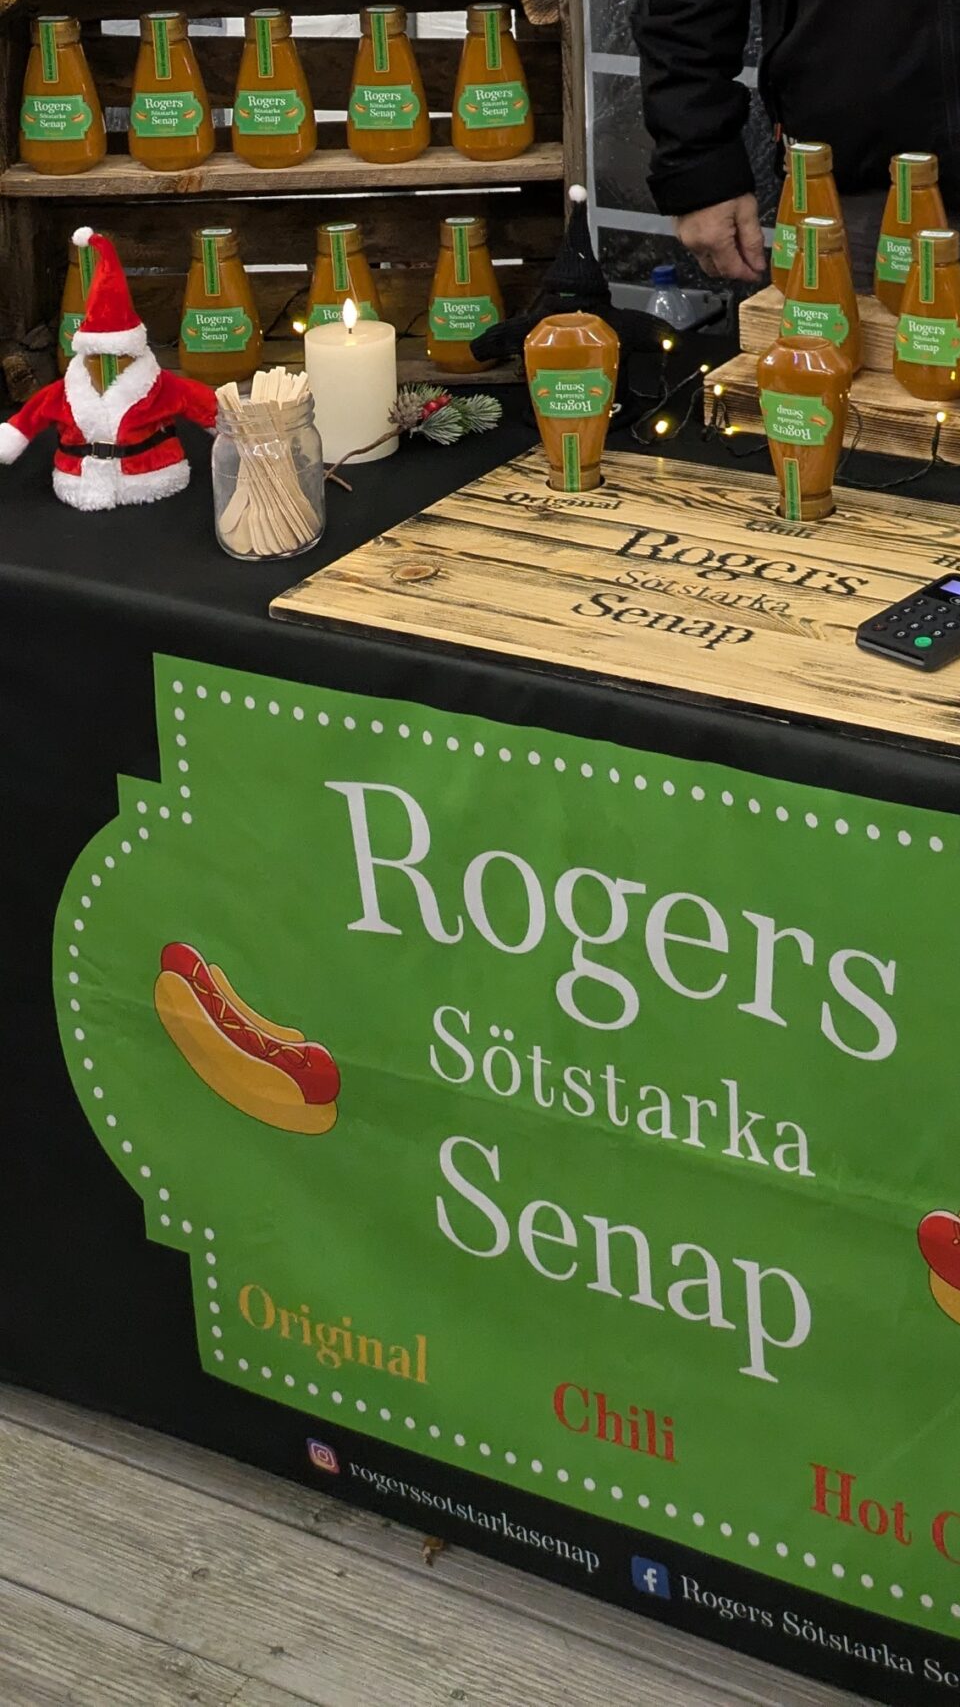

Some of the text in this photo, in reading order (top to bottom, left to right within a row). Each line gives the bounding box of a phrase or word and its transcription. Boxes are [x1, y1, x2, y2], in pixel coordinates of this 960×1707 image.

[248, 96, 286, 108] Rogers
[364, 90, 400, 102] Rogers
[475, 90, 512, 101] Rogers
[34, 101, 72, 112] Rogers
[145, 98, 183, 110] Rogers
[370, 109, 396, 118] Senap
[482, 107, 508, 116] Senap
[40, 119, 66, 130] Senap
[152, 116, 178, 126] Senap
[254, 114, 280, 124] Senap
[443, 303, 480, 314] Rogers
[793, 306, 828, 321] Rogers
[196, 314, 232, 326] Rogers
[450, 320, 475, 330] Senap
[908, 320, 946, 335] Rogers
[202, 332, 228, 343] Senap
[913, 340, 939, 354] Senap
[556, 382, 584, 392] Senap
[550, 400, 592, 412] Rogers
[777, 404, 803, 419] Senap
[772, 424, 812, 440] Rogers
[615, 529, 870, 596] Rogers
[616, 570, 791, 613] Sötstarka
[572, 592, 754, 650] Senap
[324, 781, 898, 1061] Rogers
[430, 1005, 816, 1177] Sötstarka
[436, 1136, 811, 1383] Senap
[238, 1284, 428, 1384] Original
[553, 1382, 678, 1462] Chili
[810, 1462, 912, 1546] Hot
[350, 1462, 600, 1573] rogerssotstarkasenap
[680, 1574, 774, 1628] Rogers
[782, 1611, 914, 1674] Sötstarka
